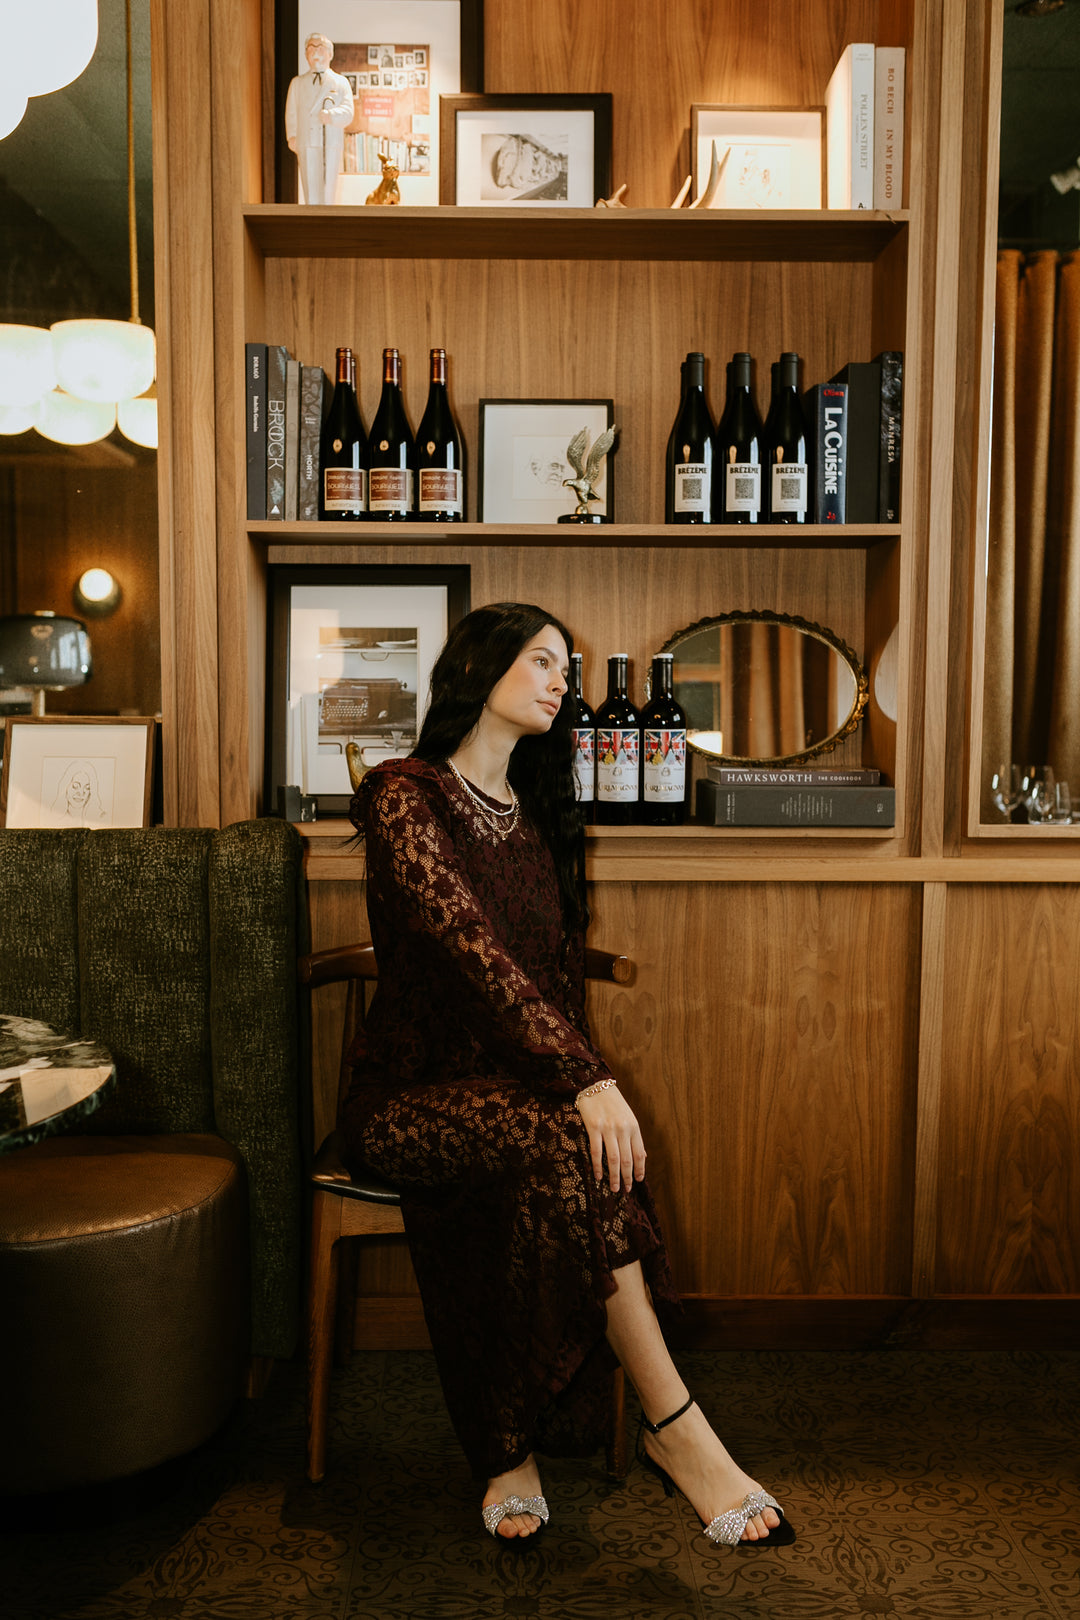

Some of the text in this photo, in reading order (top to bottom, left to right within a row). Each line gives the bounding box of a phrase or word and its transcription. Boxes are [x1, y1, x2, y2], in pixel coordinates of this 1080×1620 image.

[885, 67, 895, 199] BO BECH IN MY BLOOD
[268, 400, 285, 470] BROCK
[824, 406, 843, 430] LA
[887, 416, 896, 463] MANRESA
[305, 454, 313, 480] NORTH
[726, 773, 813, 783] HAWKSWORTH
